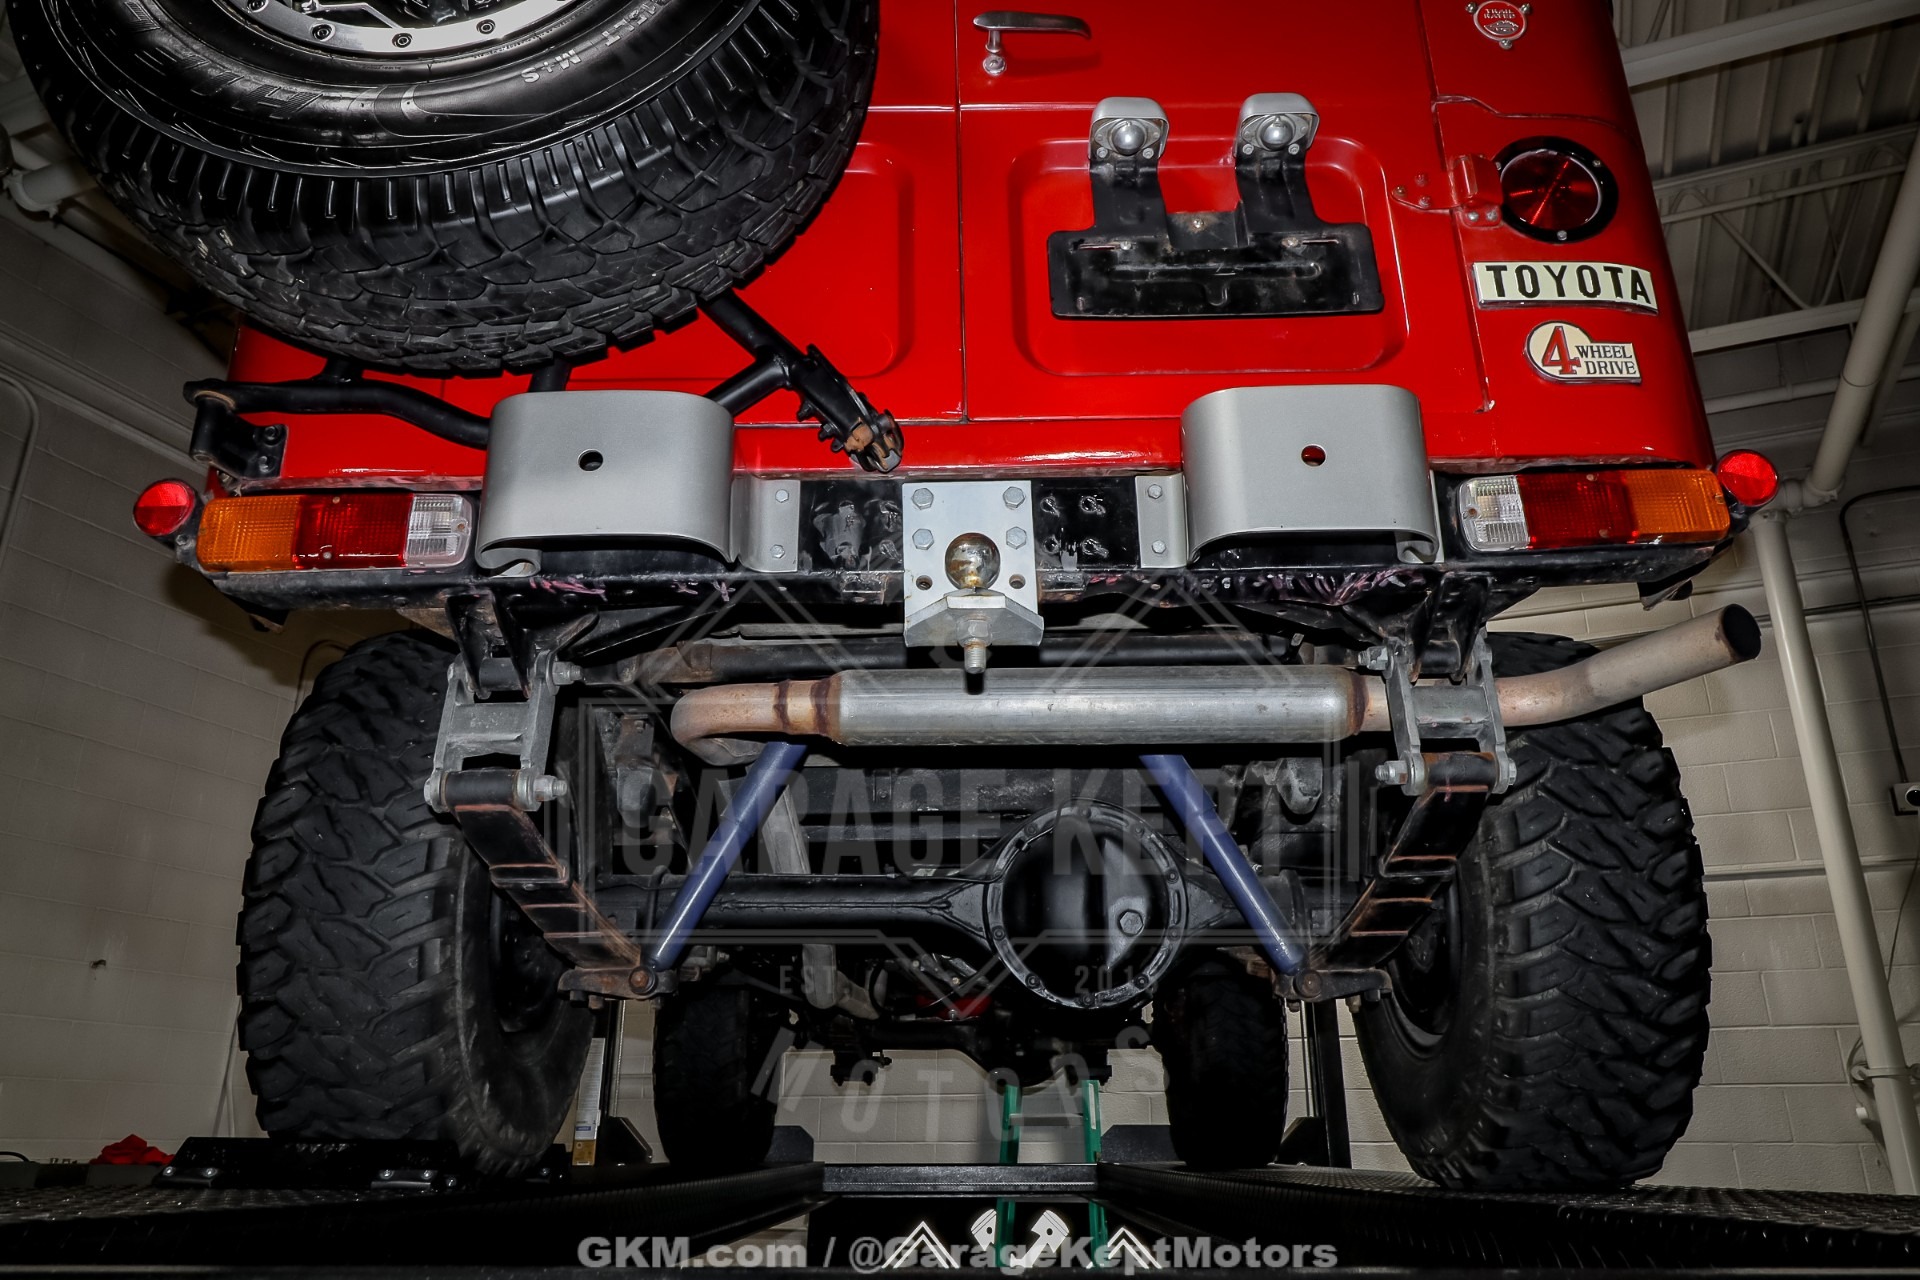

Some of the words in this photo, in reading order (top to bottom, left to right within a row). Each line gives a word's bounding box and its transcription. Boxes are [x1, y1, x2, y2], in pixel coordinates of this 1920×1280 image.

[521, 50, 582, 83] M+S
[1486, 264, 1652, 305] TOYOTA
[1542, 326, 1581, 375] 4
[1575, 345, 1633, 359] WHEEL
[1584, 360, 1637, 375] DRIVE
